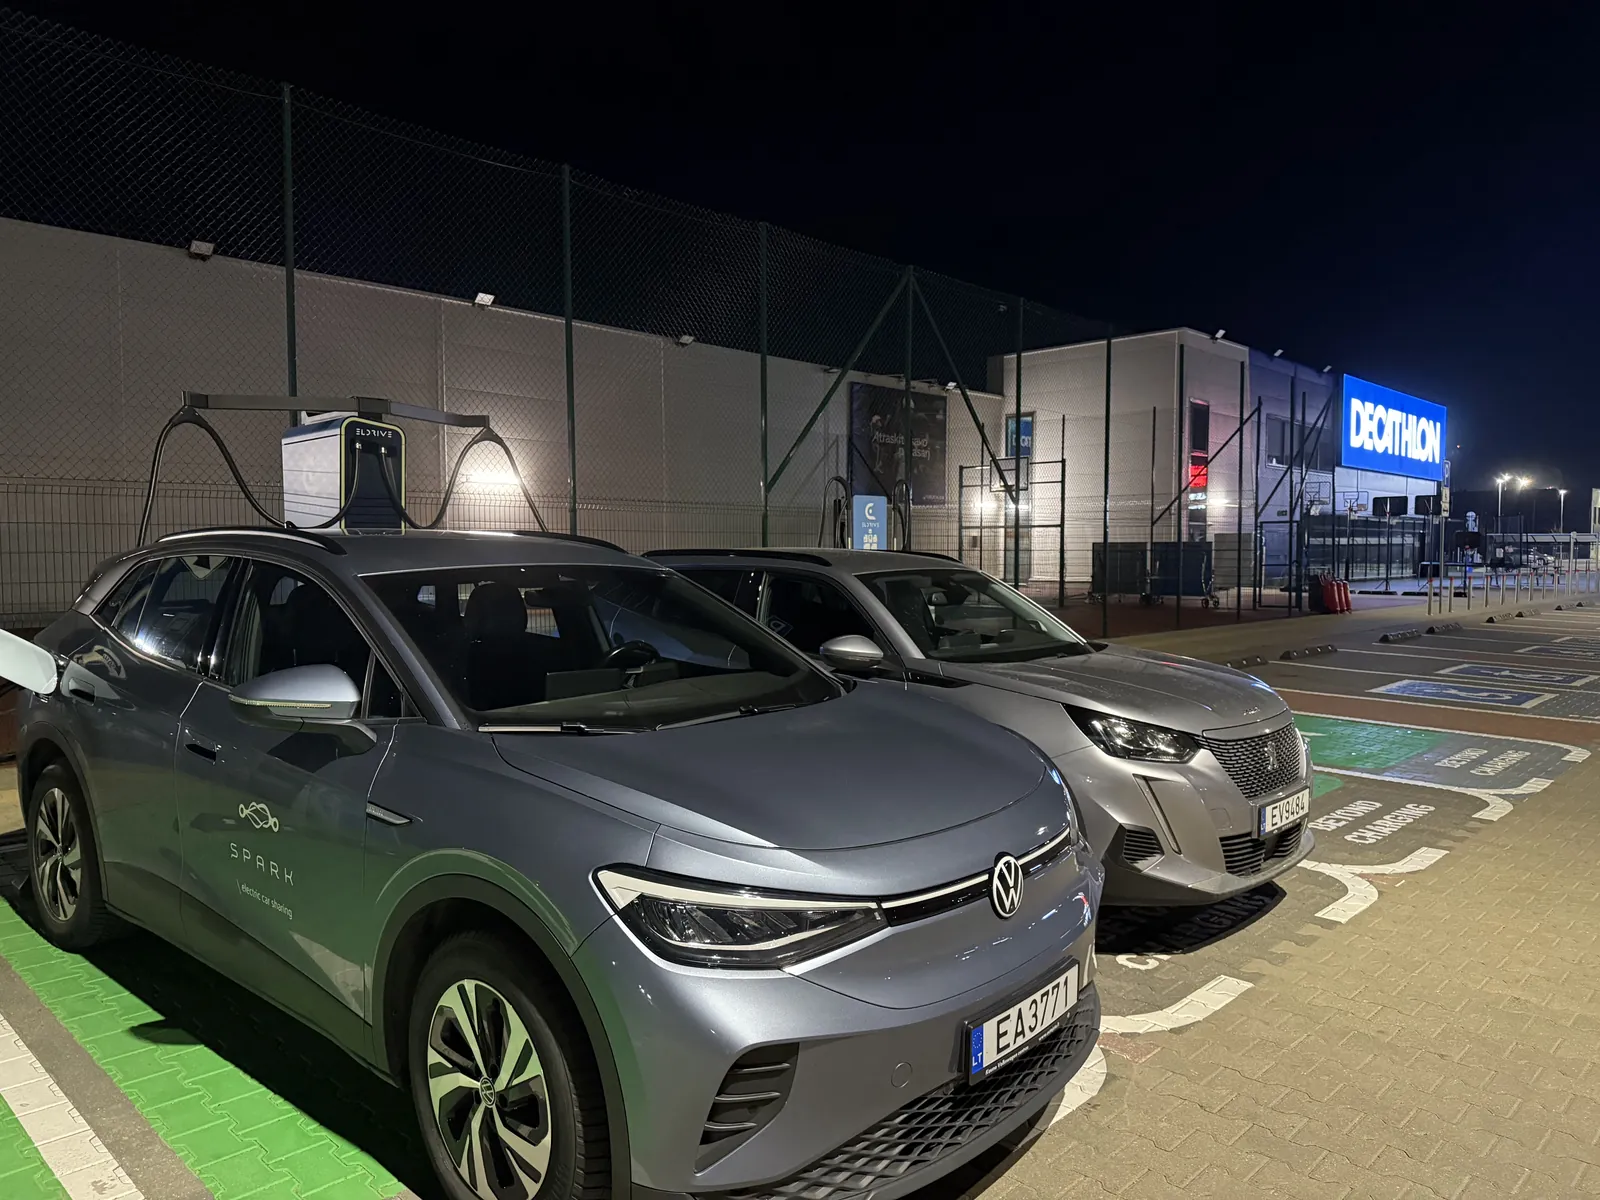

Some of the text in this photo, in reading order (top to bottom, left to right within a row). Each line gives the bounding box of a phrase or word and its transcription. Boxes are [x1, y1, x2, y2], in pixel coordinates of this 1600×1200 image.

[356, 428, 392, 438] ELDRIVE
[872, 431, 905, 445] Atraskit
[1350, 397, 1440, 464] DECATHLON
[1271, 793, 1305, 828] EV9484
[1307, 800, 1383, 832] BEYOND
[1344, 803, 1436, 844] CHARGING
[230, 842, 294, 887] SPARK
[241, 883, 293, 920] electric car sharing
[996, 975, 1069, 1056] EA3771
[972, 1051, 983, 1067] LT
